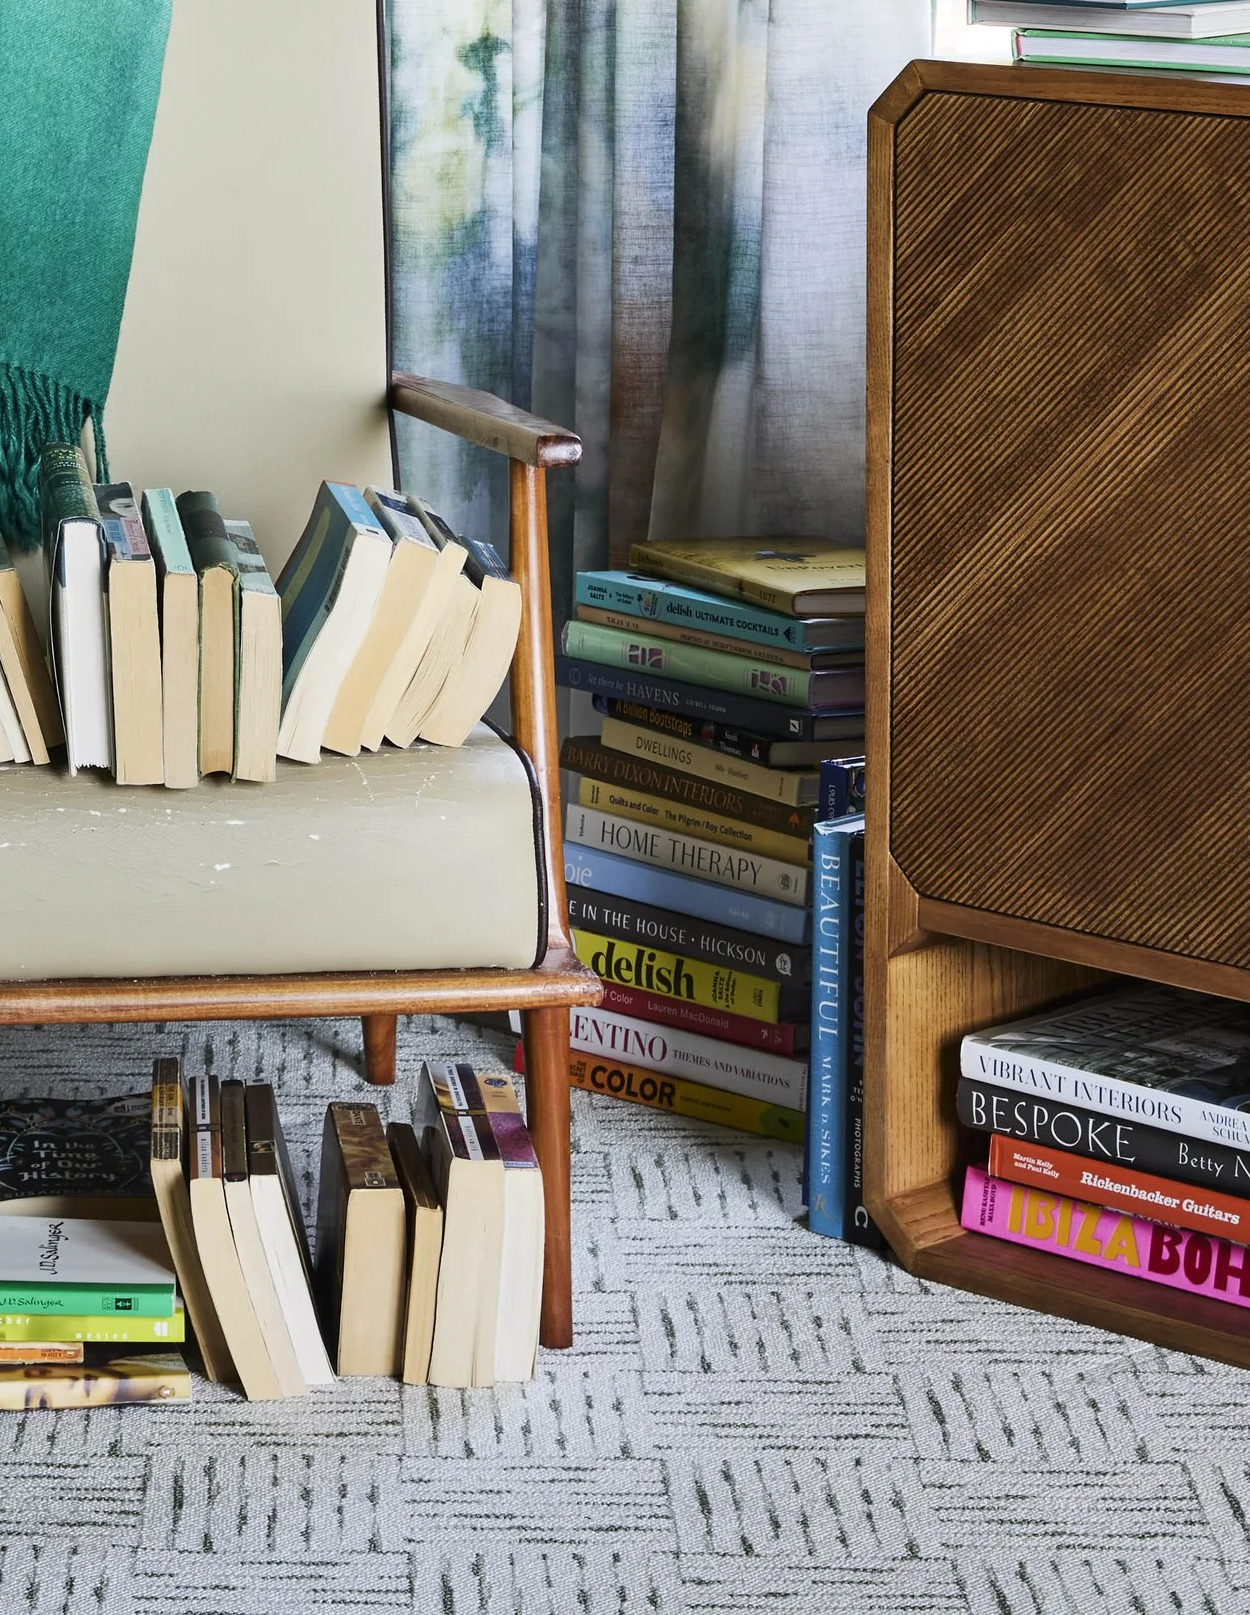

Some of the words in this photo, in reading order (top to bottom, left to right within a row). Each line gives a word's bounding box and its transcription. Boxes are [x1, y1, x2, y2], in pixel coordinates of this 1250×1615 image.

[759, 590, 777, 603] LUTZ
[666, 602, 693, 618] delish
[695, 609, 735, 627] ULTIMATE
[736, 618, 779, 637] COCKTAILS
[626, 682, 680, 706] HAVENS
[623, 701, 648, 721] Billion
[649, 707, 693, 737] Bootstraps
[636, 736, 693, 765] DWELLINGS
[566, 746, 612, 773] BARRY
[613, 759, 664, 786] DIXON
[664, 771, 744, 815] INTERIORS
[609, 795, 628, 808] Quilts
[628, 799, 642, 811] and
[643, 802, 660, 815] Color
[665, 810, 677, 821] The
[678, 813, 702, 830] Pilgrim
[706, 822, 719, 833] Roy
[720, 824, 753, 841] Collection
[601, 820, 660, 859] HOME
[669, 838, 763, 886] THERAPY
[583, 904, 598, 921] IN
[603, 908, 631, 930] THE
[637, 918, 687, 945] HOUSE
[701, 935, 766, 966] HICKSON
[819, 852, 842, 1041] BEAUTIFUL
[592, 941, 696, 1001] delish
[610, 990, 634, 1005] Color
[648, 1000, 678, 1017] Lauren
[680, 1008, 729, 1030] MacDonald
[569, 1013, 668, 1063] ENTINO
[673, 1049, 711, 1068] THEMES
[713, 1060, 732, 1075] AND
[732, 1063, 791, 1090] VARIATIONS
[590, 1064, 677, 1108] COLOR
[821, 1055, 832, 1107] MARK
[979, 1055, 1067, 1094] VIBRANT
[1074, 1079, 1183, 1124] INTERIORS
[971, 1091, 1136, 1163] BESPOKE
[1178, 1142, 1224, 1178] Betty
[1199, 1109, 1248, 1131] ANDREA
[30, 1160, 50, 1169] of
[33, 1140, 56, 1149] In
[821, 1129, 831, 1185] SIKES
[1013, 1153, 1036, 1165] Martin
[1036, 1158, 1054, 1170] Kelly
[1014, 1161, 1027, 1169] and
[1027, 1164, 1042, 1173] Paul
[1043, 1169, 1060, 1179] Kelly
[1081, 1171, 1180, 1209] Rickenbacker
[1181, 1198, 1241, 1225] Guitars
[1007, 1183, 1141, 1268] IBIZA
[1148, 1224, 1250, 1297] BOH
[75, 1332, 128, 1340] wasted
